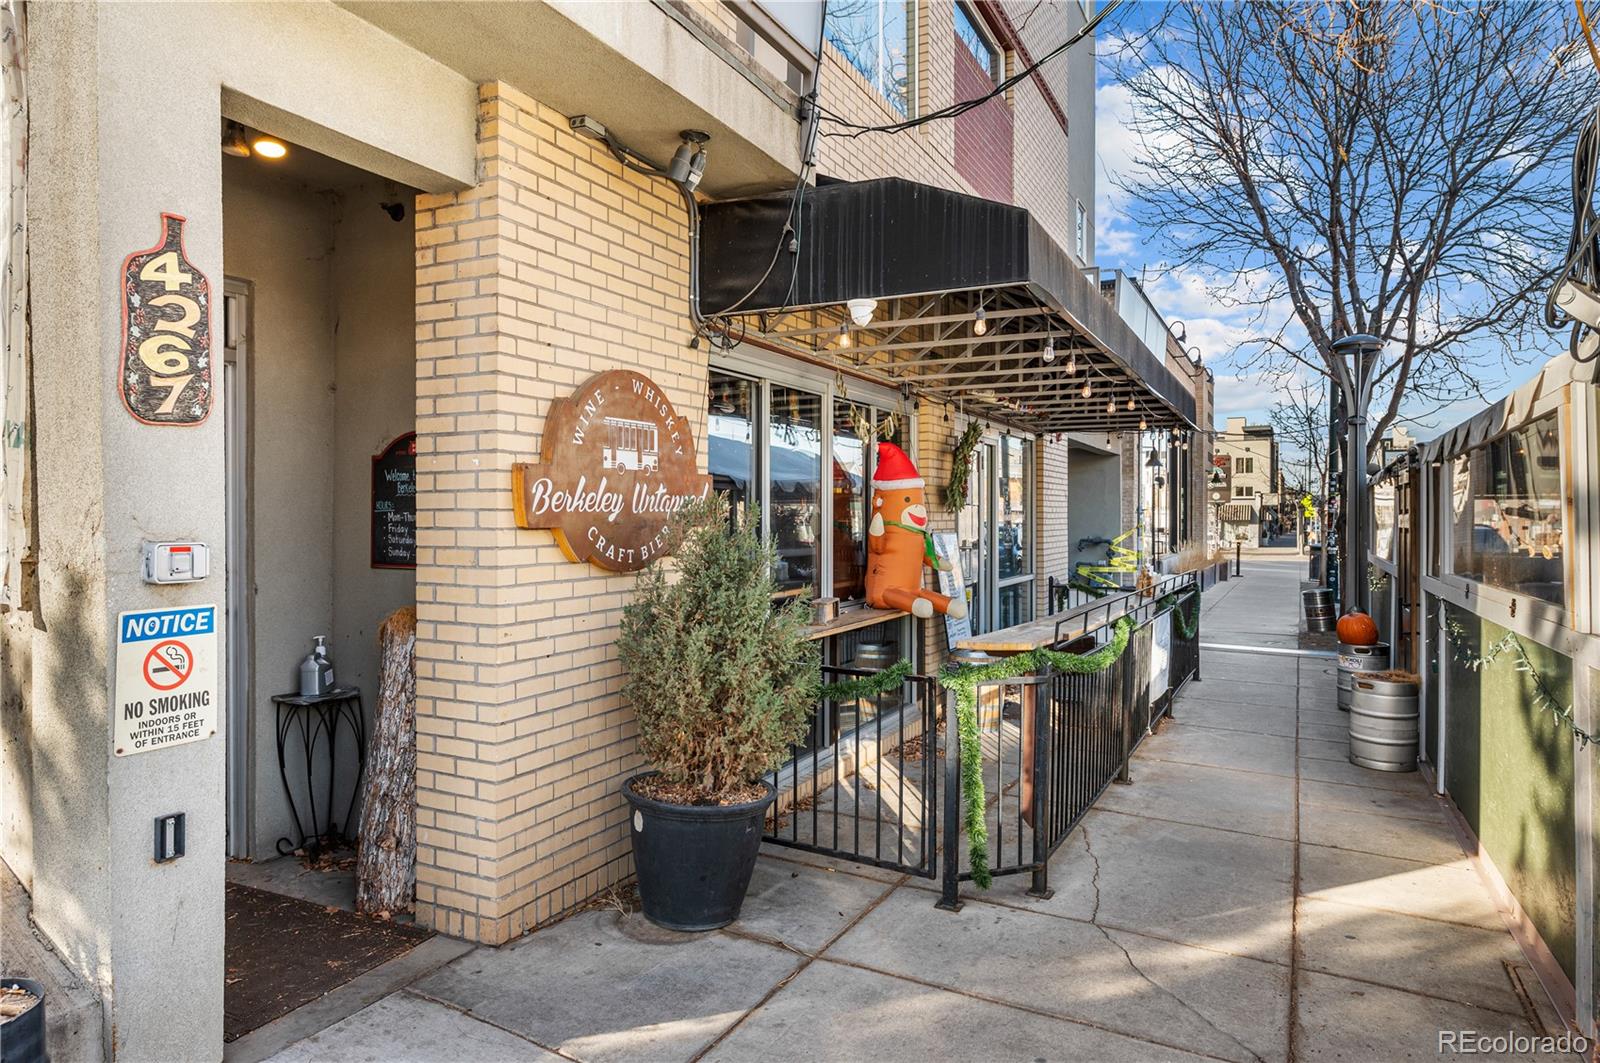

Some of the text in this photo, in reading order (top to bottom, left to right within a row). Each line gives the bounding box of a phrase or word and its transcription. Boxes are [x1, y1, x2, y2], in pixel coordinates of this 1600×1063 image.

[139, 251, 202, 414] 4267
[572, 378, 684, 457] WINE WHISKEY
[384, 468, 410, 482] Welcome
[531, 475, 625, 522] Berkeley
[388, 522, 409, 537] Friday
[387, 546, 410, 560] Sunday
[587, 526, 634, 563] CRAFT
[126, 611, 211, 639] NOTICE
[124, 690, 210, 721] NO SMOKING
[130, 719, 205, 740] WITHIN 15 FEET
[138, 711, 197, 729] INDOORS OR
[135, 728, 200, 749] OF ENTRANCE
